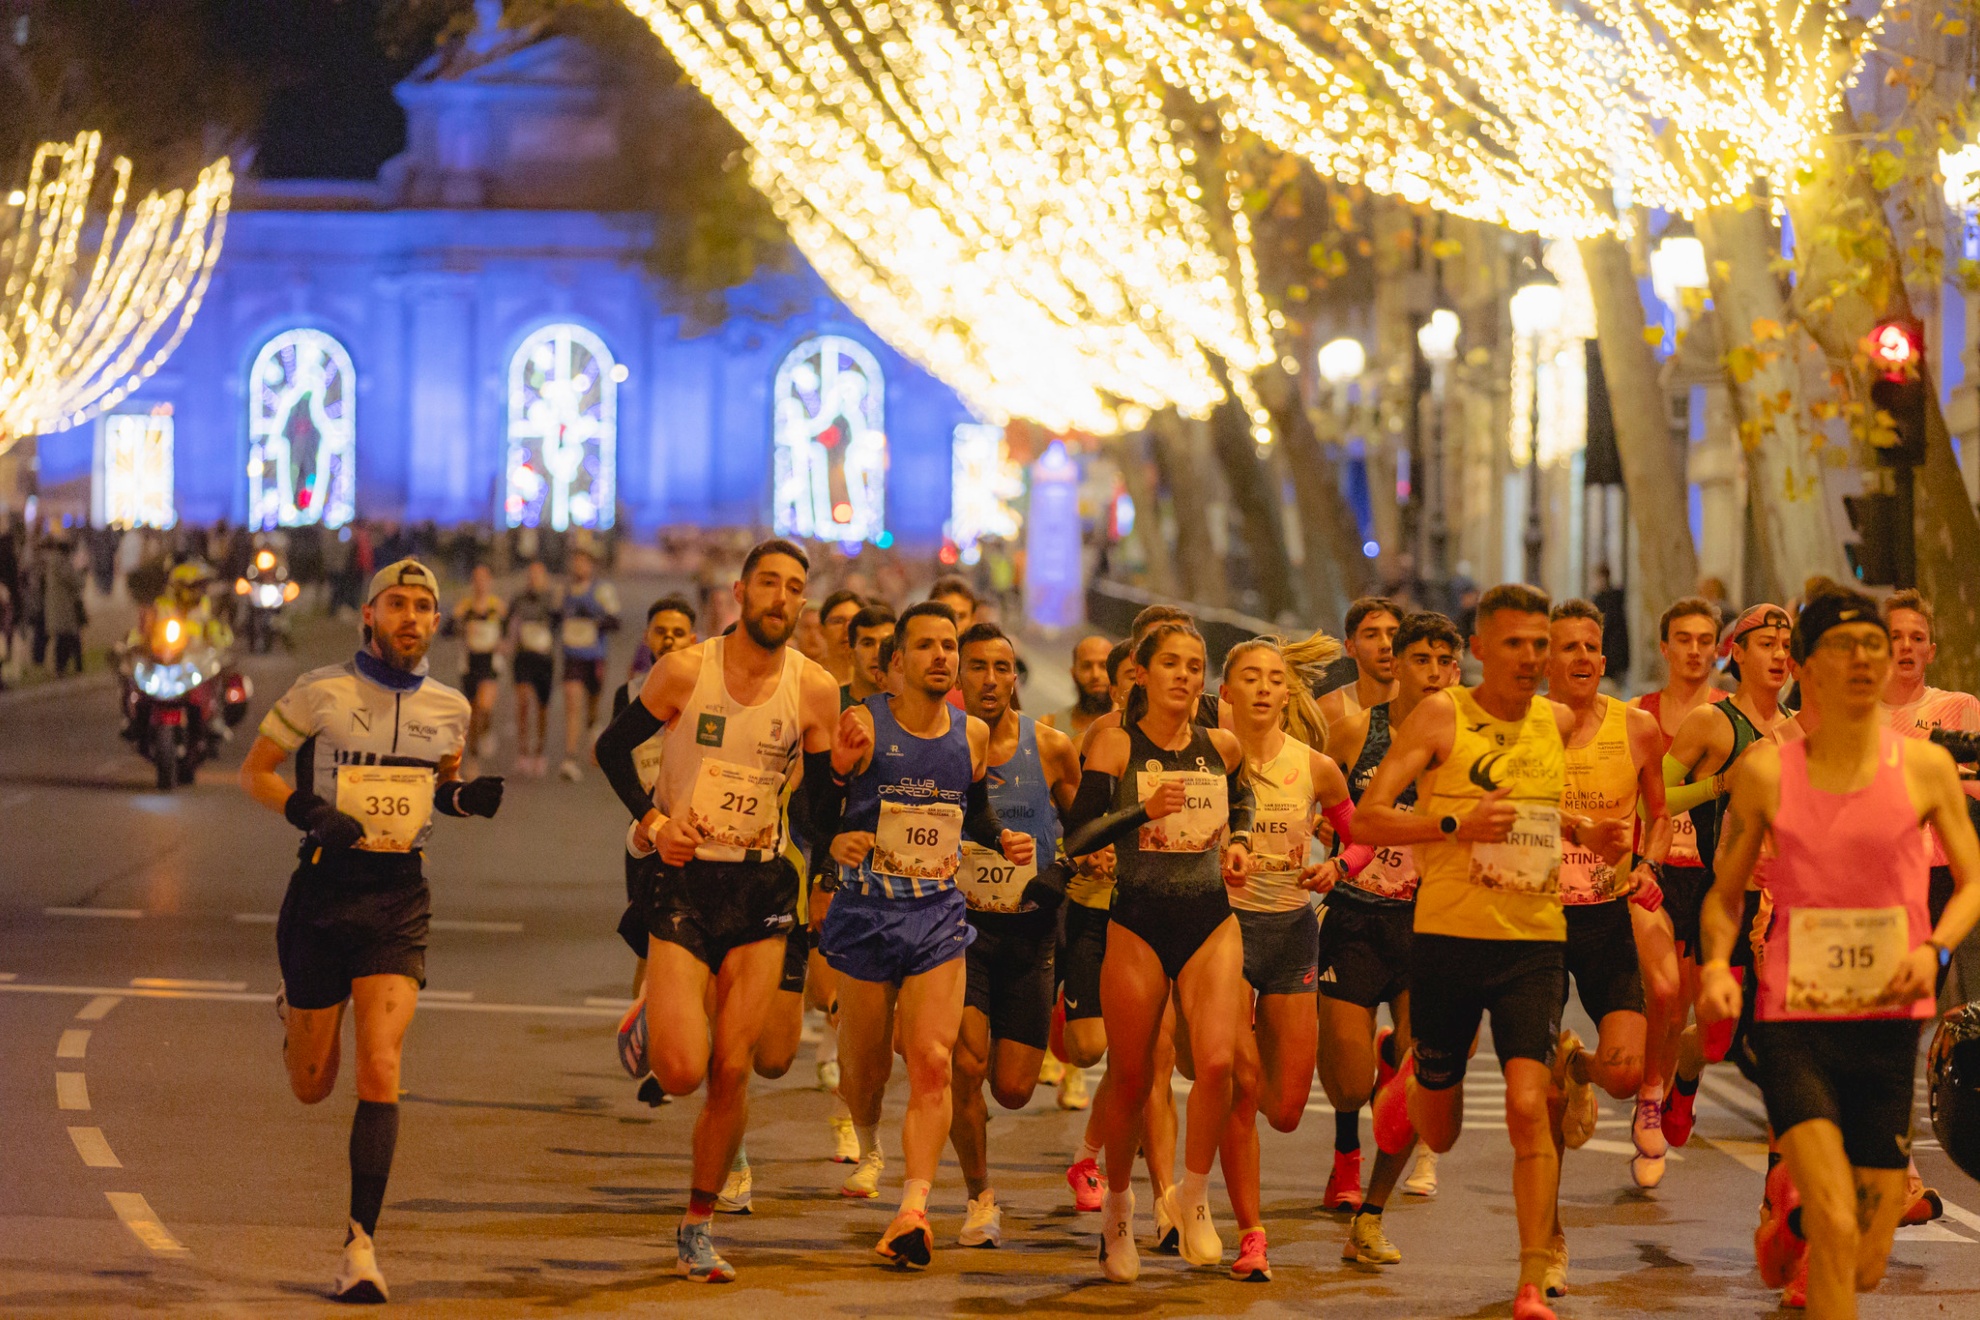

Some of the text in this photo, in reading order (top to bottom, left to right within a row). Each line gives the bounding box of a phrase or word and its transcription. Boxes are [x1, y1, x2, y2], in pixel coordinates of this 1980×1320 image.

[900, 777, 935, 788] CLUB
[720, 792, 758, 816] 212
[1565, 790, 1604, 800] CLÍNICA
[366, 796, 410, 816] 336
[1565, 800, 1620, 810] MENORCA
[905, 827, 939, 846] 168
[1373, 845, 1404, 868] 45
[976, 866, 1016, 884] 207
[1828, 944, 1875, 969] 315
